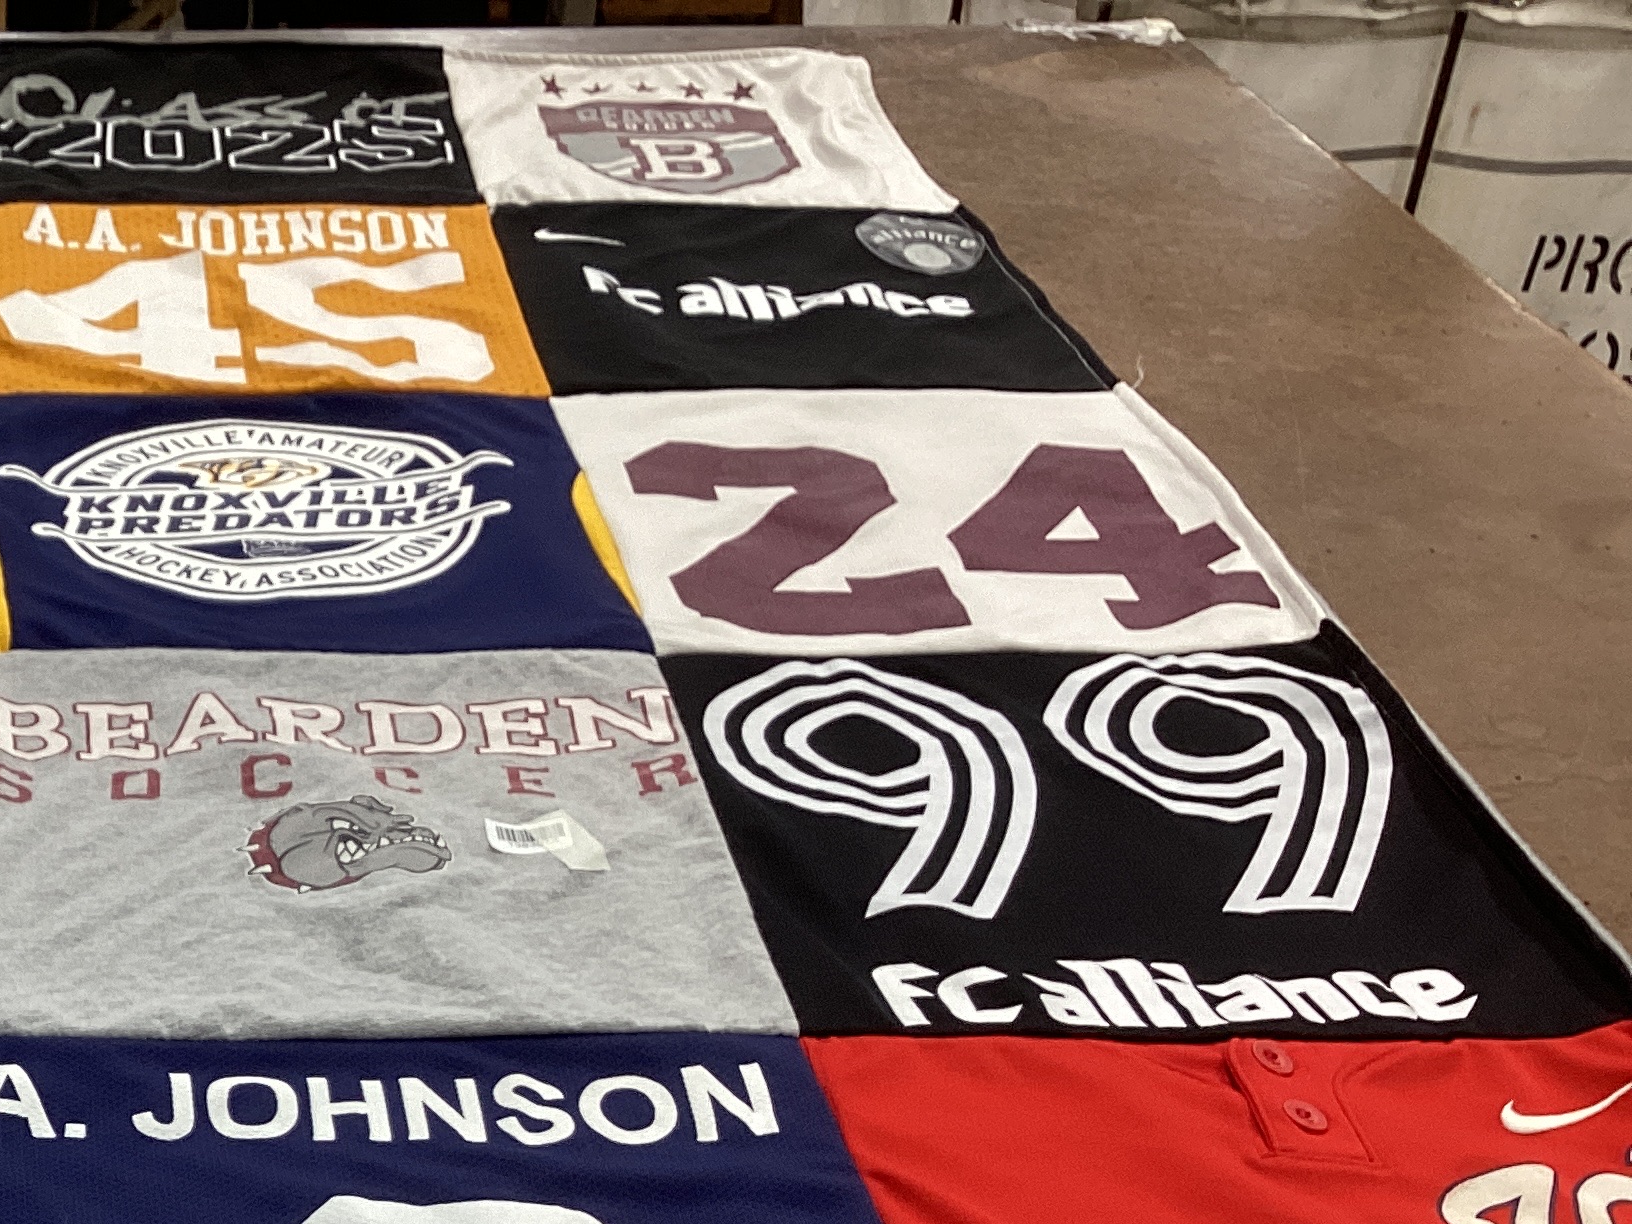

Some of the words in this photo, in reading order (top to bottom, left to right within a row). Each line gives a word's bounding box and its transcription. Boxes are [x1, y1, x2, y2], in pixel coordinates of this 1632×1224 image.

[630, 136, 730, 181] B
[158, 210, 449, 256] JOHNSON
[86, 428, 241, 478] KNOXVILLE
[256, 431, 406, 469] AMATEUR
[74, 490, 464, 536] PREDATORS
[76, 474, 454, 514] KNOXVILLE
[115, 543, 240, 588] HOCKEY
[255, 532, 444, 589] ASSOCIATION
[623, 440, 1282, 637] 24
[702, 652, 1394, 920] 99
[870, 961, 1024, 1027] FC
[1020, 957, 1480, 1028] alliance
[130, 1061, 780, 1146] JOHNSON
